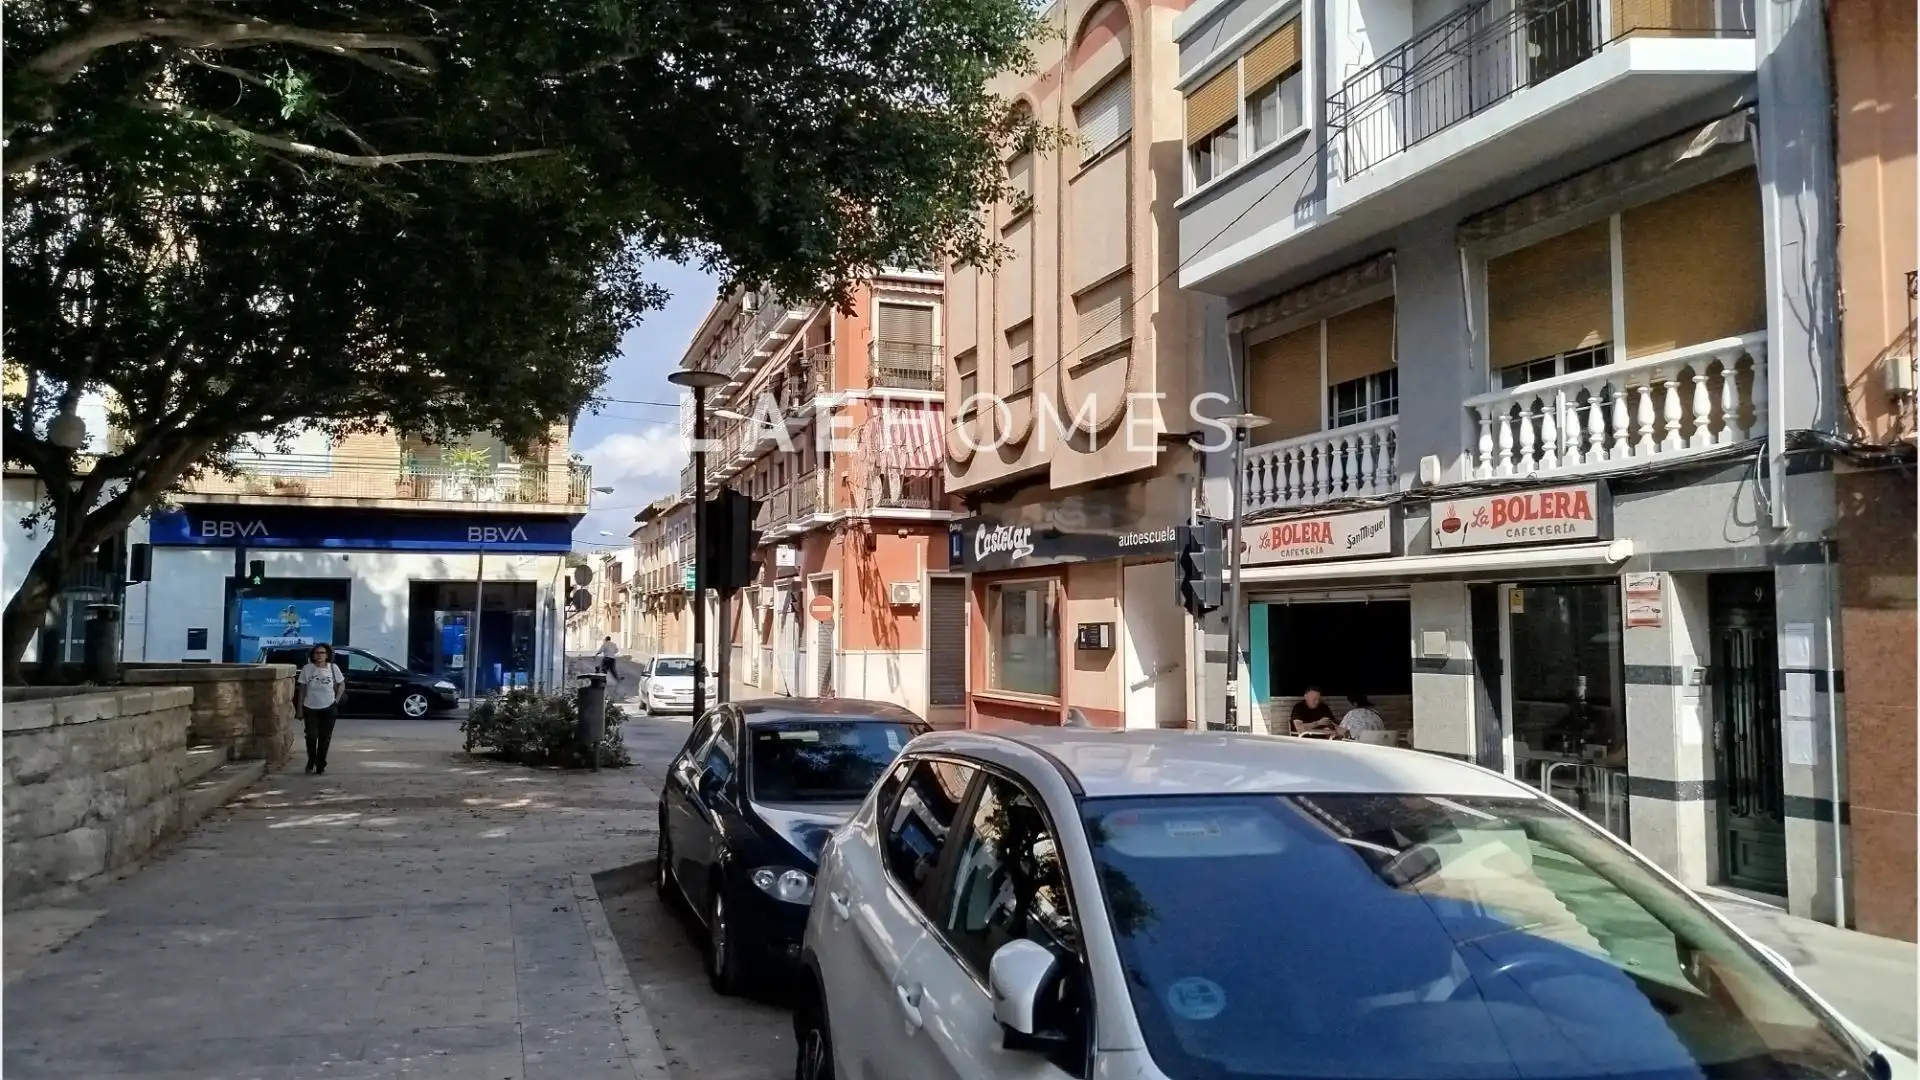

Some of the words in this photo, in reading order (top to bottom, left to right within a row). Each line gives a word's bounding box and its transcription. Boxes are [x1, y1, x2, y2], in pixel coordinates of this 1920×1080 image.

[1470, 506, 1489, 528] La
[1491, 490, 1594, 529] BOLERA
[201, 520, 269, 537] BBVA
[467, 526, 528, 542] BBVA
[1118, 526, 1176, 547] autoescuela
[1259, 531, 1271, 549] La
[1271, 521, 1334, 550] BOLERA
[1506, 522, 1576, 538] CAFETERÍA
[1280, 546, 1324, 558] CAFETERÍA
